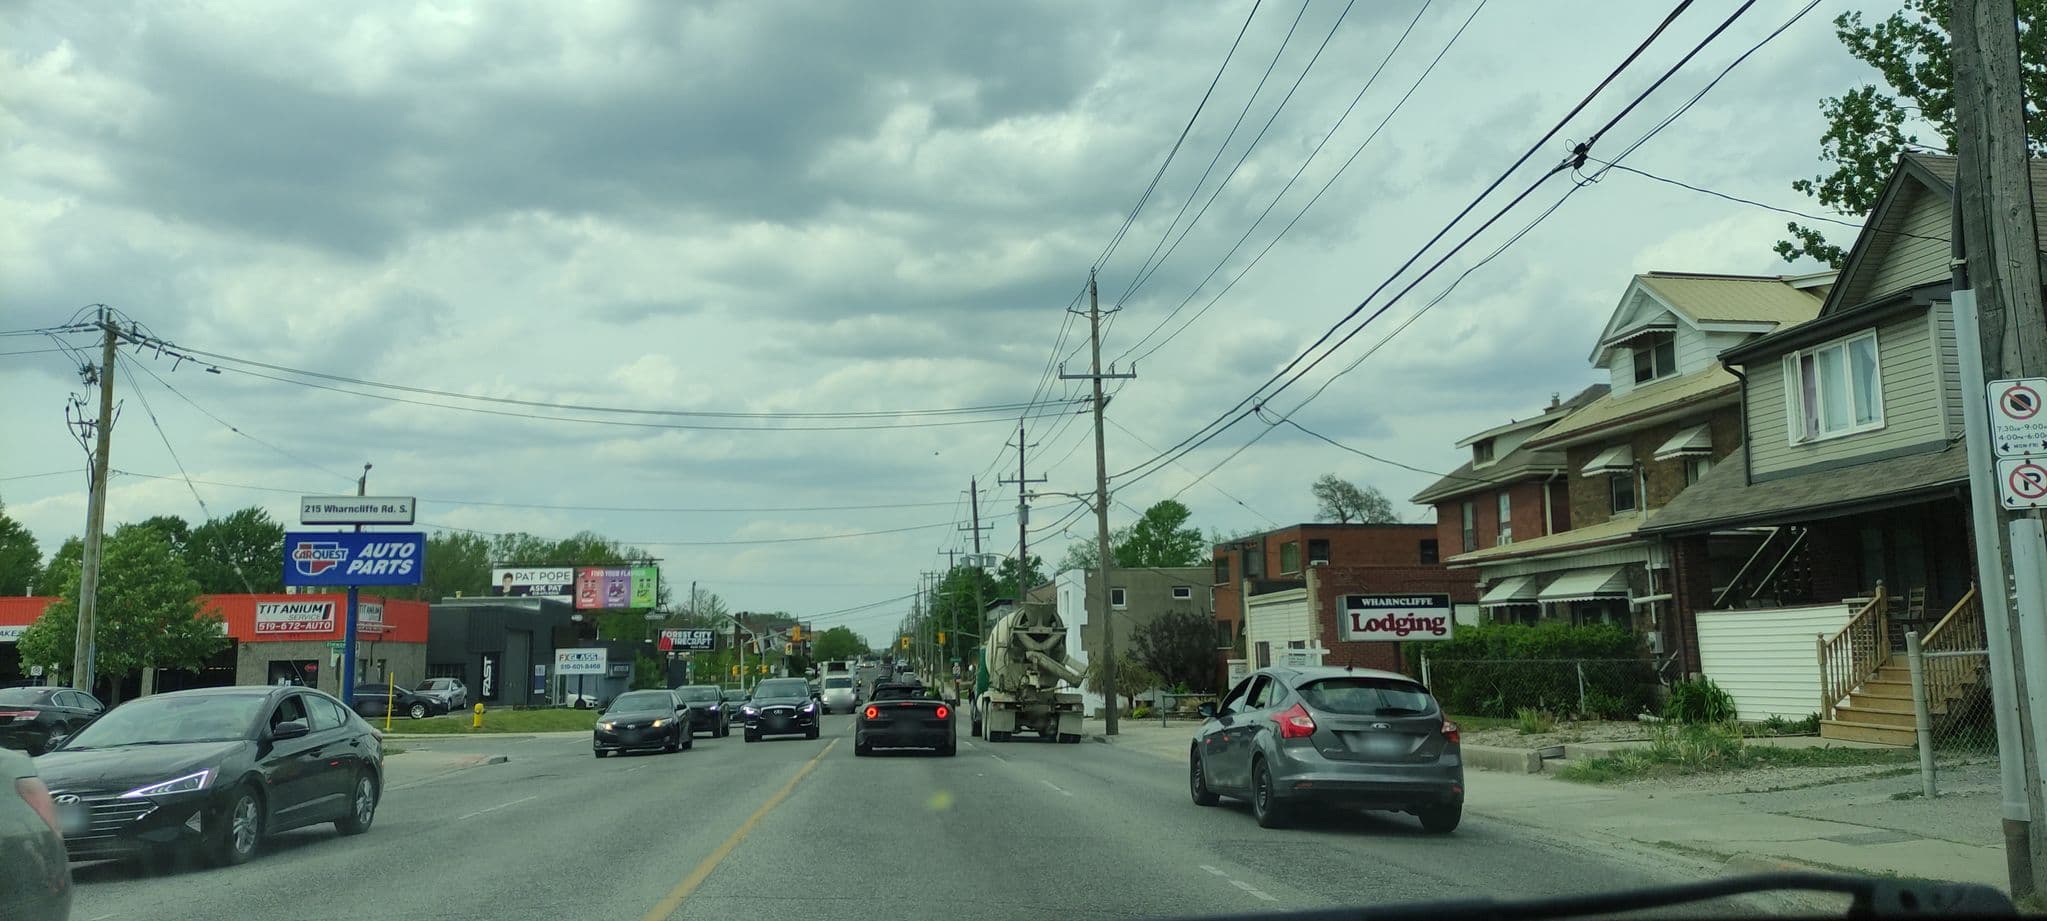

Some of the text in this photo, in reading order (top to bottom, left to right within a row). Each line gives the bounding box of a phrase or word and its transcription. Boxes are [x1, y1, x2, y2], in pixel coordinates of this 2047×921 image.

[304, 504, 408, 513] 215 Wharncliffe Rd. S.
[294, 548, 347, 560] CARQUEST
[358, 543, 416, 558] AUTO
[346, 560, 414, 575] PARTS
[515, 571, 571, 582] PAT POPE
[529, 585, 563, 593] ASK PAT
[1361, 597, 1434, 607] WHARNCLIFFE
[259, 604, 323, 614] TITANIUM
[258, 622, 332, 631] 519-672-AUTO
[1351, 612, 1447, 637] Lodging
[661, 630, 712, 638] FOREST CITY
[483, 655, 493, 697] FAST
